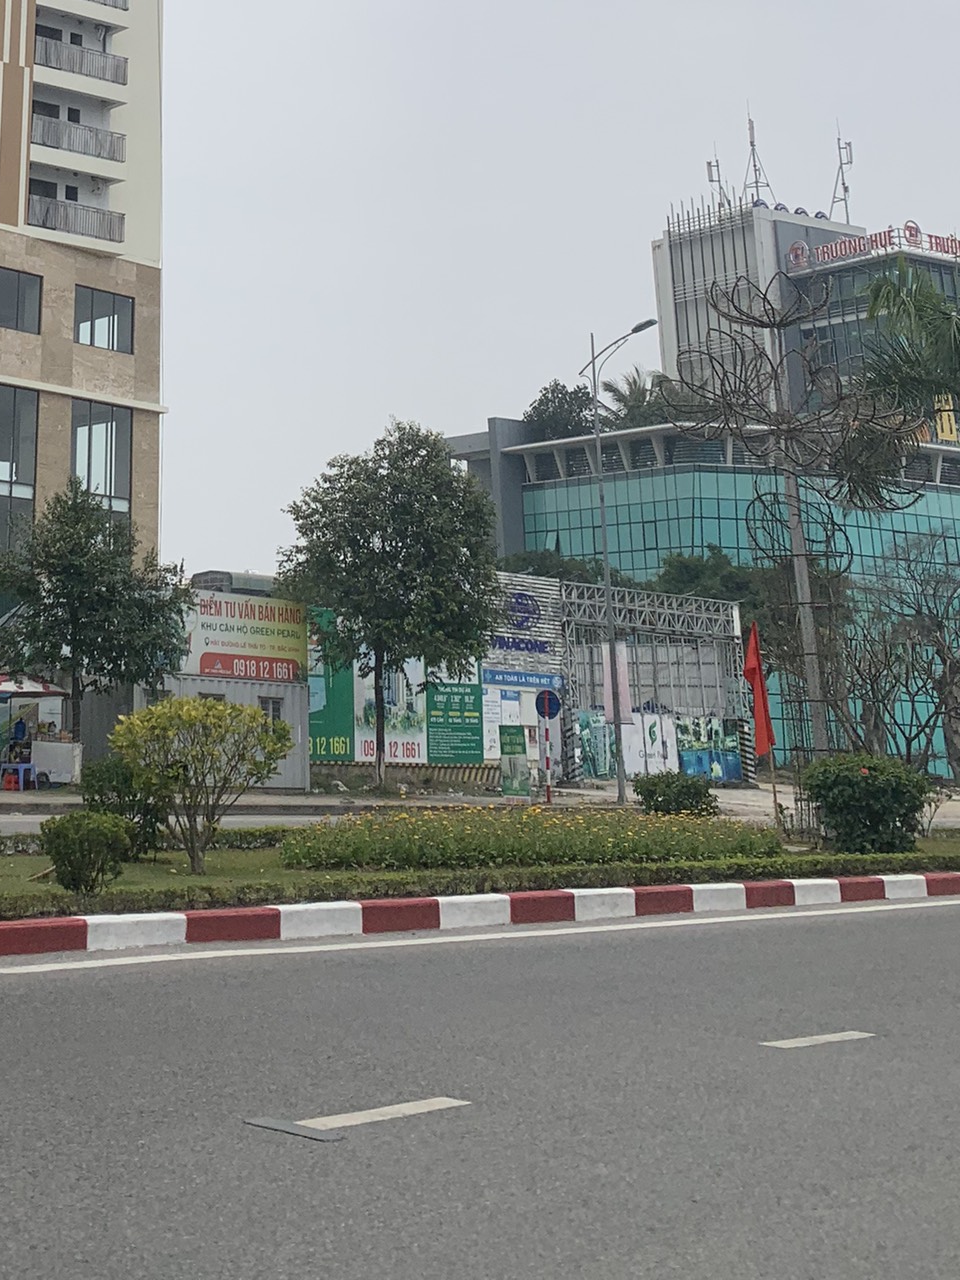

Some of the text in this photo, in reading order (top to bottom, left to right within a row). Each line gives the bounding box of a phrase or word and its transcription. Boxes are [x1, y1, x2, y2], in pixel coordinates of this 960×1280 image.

[928, 233, 960, 257] TRƯỜ
[238, 598, 256, 620] VẤN
[258, 602, 276, 622] BÁN
[278, 603, 301, 625] HÀNG
[201, 622, 217, 631] KHU
[219, 623, 235, 633] CĂN
[237, 625, 248, 636] HỘ
[250, 626, 275, 635] GREEN
[233, 659, 294, 679] 0918 12 1661
[316, 738, 327, 754] 12
[329, 737, 350, 755] 1661
[388, 741, 398, 758] 12
[401, 742, 421, 758] 1661
